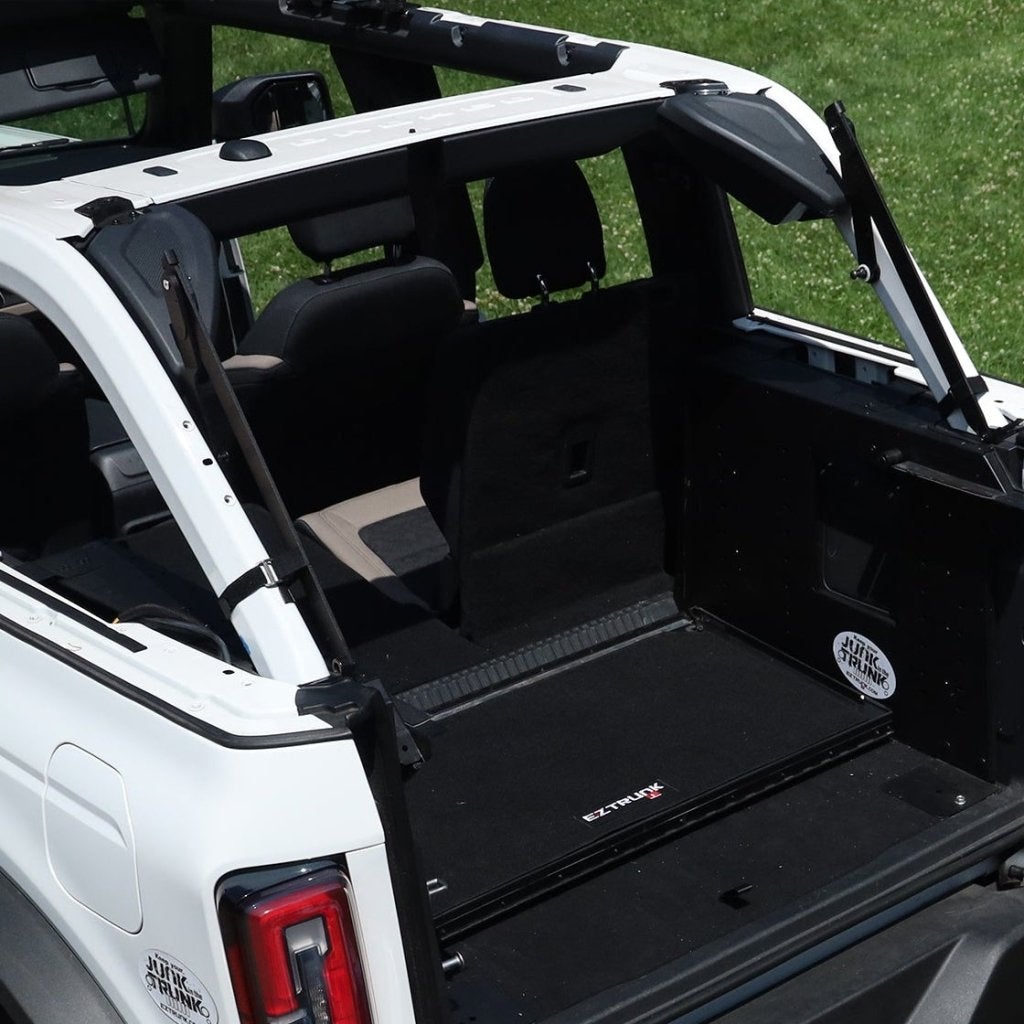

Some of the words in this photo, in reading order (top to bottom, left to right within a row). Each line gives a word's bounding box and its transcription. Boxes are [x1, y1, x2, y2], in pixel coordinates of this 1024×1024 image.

[841, 636, 879, 669] JUNK
[841, 647, 887, 685] TRUNK
[582, 782, 664, 822] EZTRUNK
[146, 955, 188, 993] JUNK
[147, 971, 202, 1013] TRUNK
